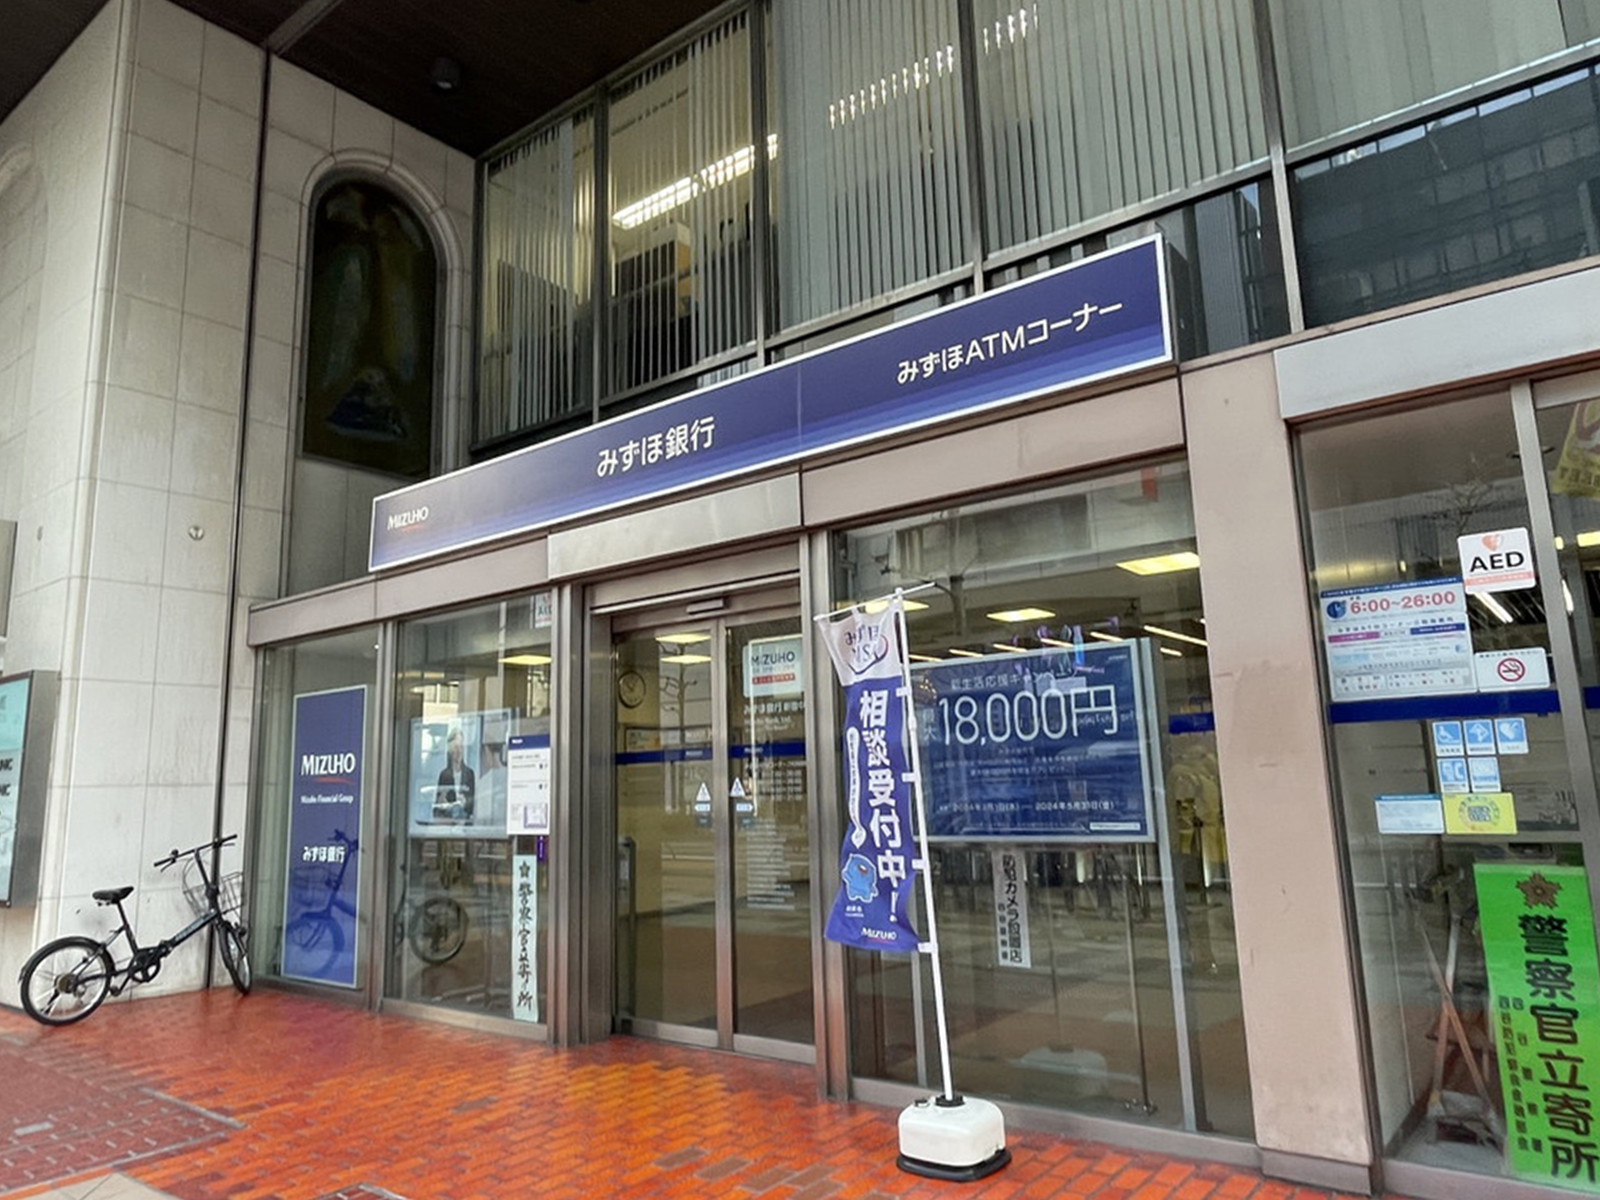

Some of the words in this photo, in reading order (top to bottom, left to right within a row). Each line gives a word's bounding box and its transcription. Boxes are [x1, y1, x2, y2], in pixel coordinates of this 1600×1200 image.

[897, 302, 1123, 384] みずほATMコーナー
[597, 416, 715, 478] みずほ銀行
[387, 506, 429, 531] MIZUHO
[1469, 551, 1525, 573] AED
[939, 684, 1119, 746] 18,000円
[301, 753, 355, 775] MIZUHO
[302, 846, 345, 863] みずほ銀行
[1518, 914, 1599, 1183] 警察官立寄所
